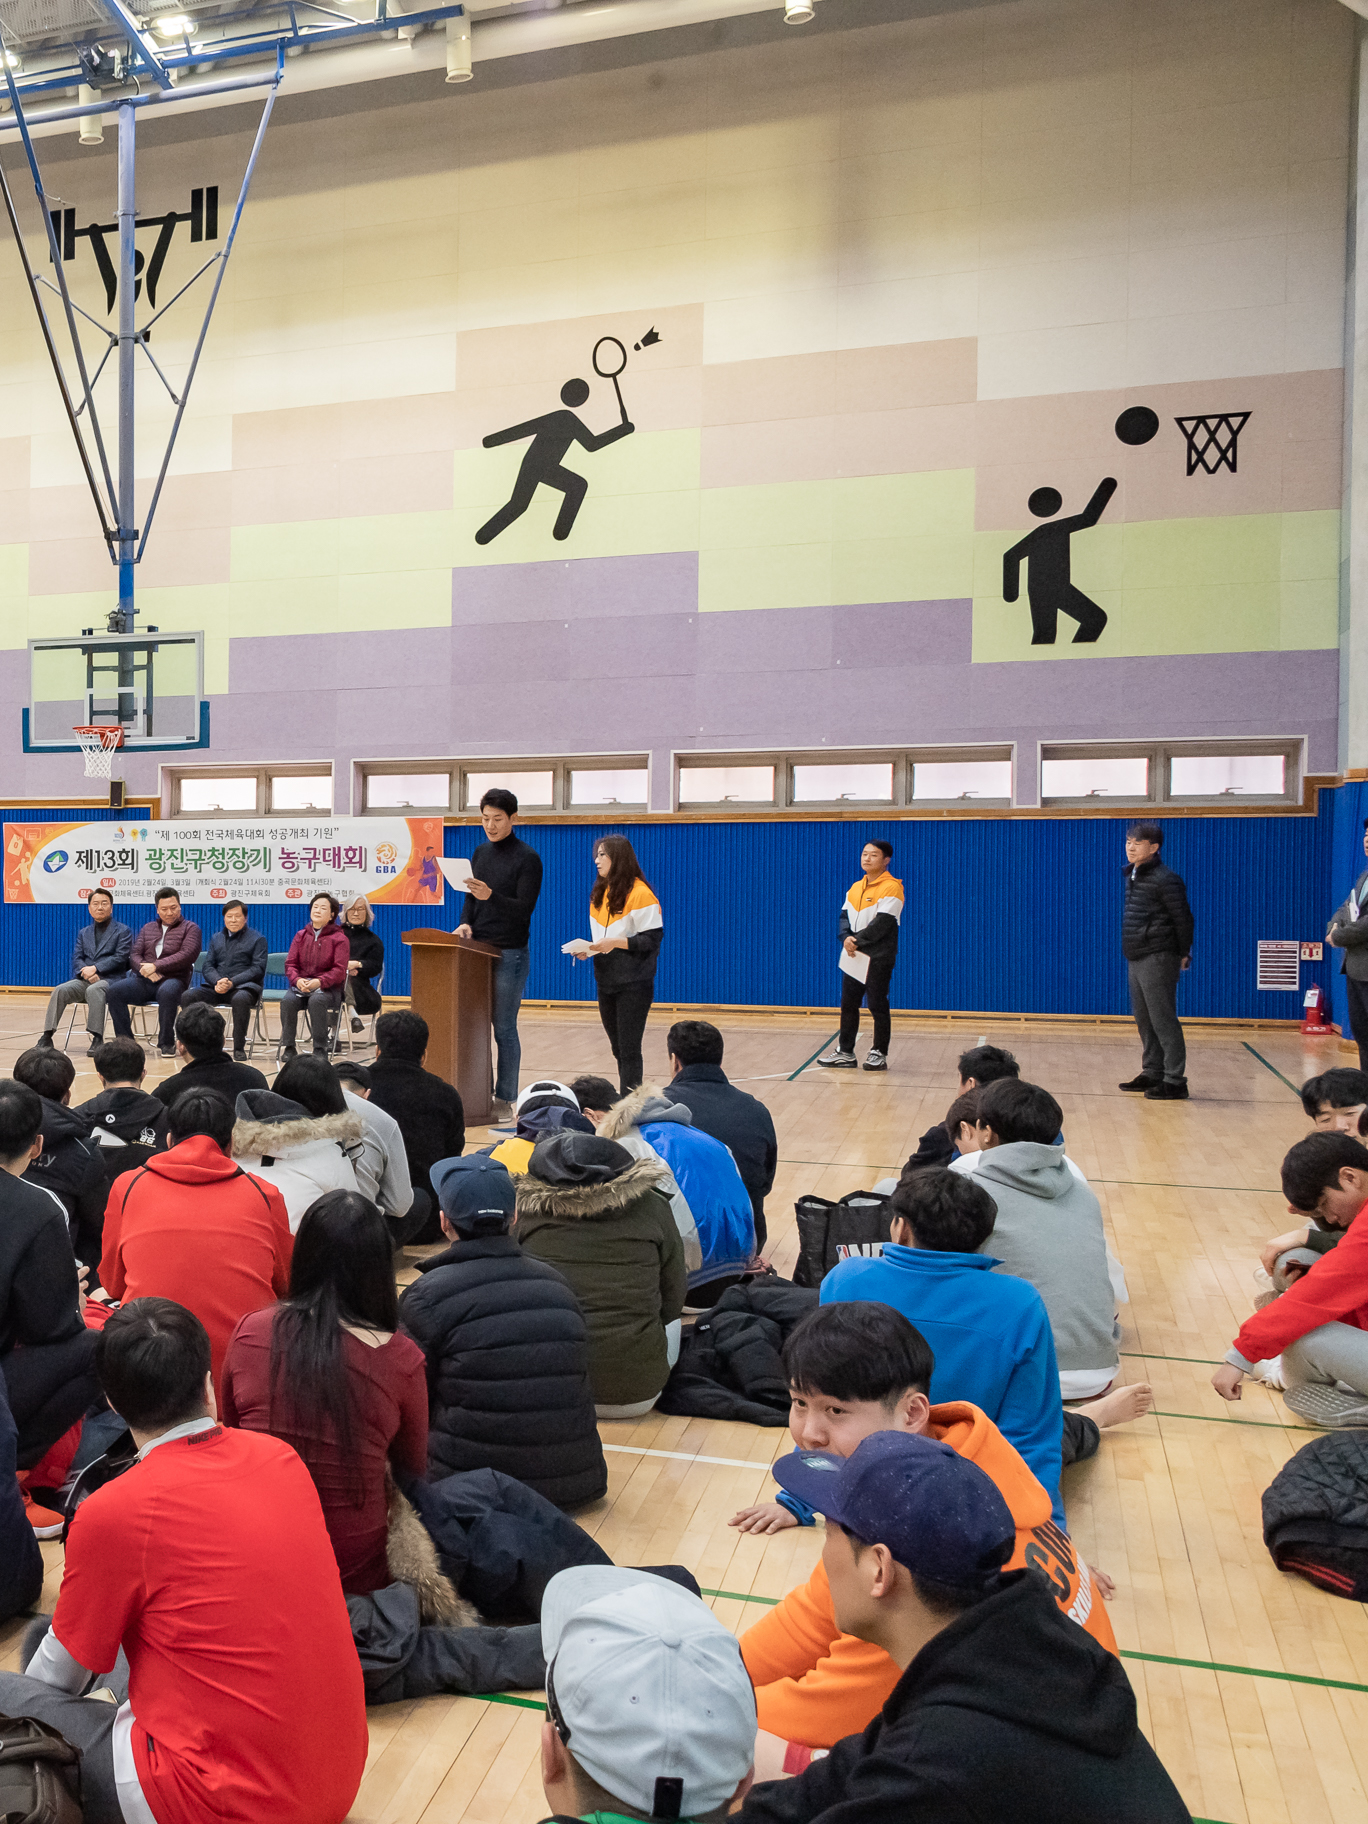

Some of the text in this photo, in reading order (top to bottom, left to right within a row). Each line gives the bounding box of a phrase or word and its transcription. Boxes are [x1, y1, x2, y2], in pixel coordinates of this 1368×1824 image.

[173, 829, 201, 841] 100회
[205, 828, 265, 841] 전국체육대회
[268, 828, 309, 840] 성공개최
[74, 845, 367, 873] 제13회 광진구청장기 농구대회
[375, 865, 397, 874] GBA
[102, 878, 115, 887] 일시
[118, 878, 140, 886] 2019년
[170, 878, 191, 886] 3월3일
[218, 878, 244, 886] 2월24일
[246, 878, 275, 886] 11시30분
[230, 889, 271, 898] 광진구체육회
[287, 888, 302, 898] 주관
[187, 1430, 209, 1446] NIKE
